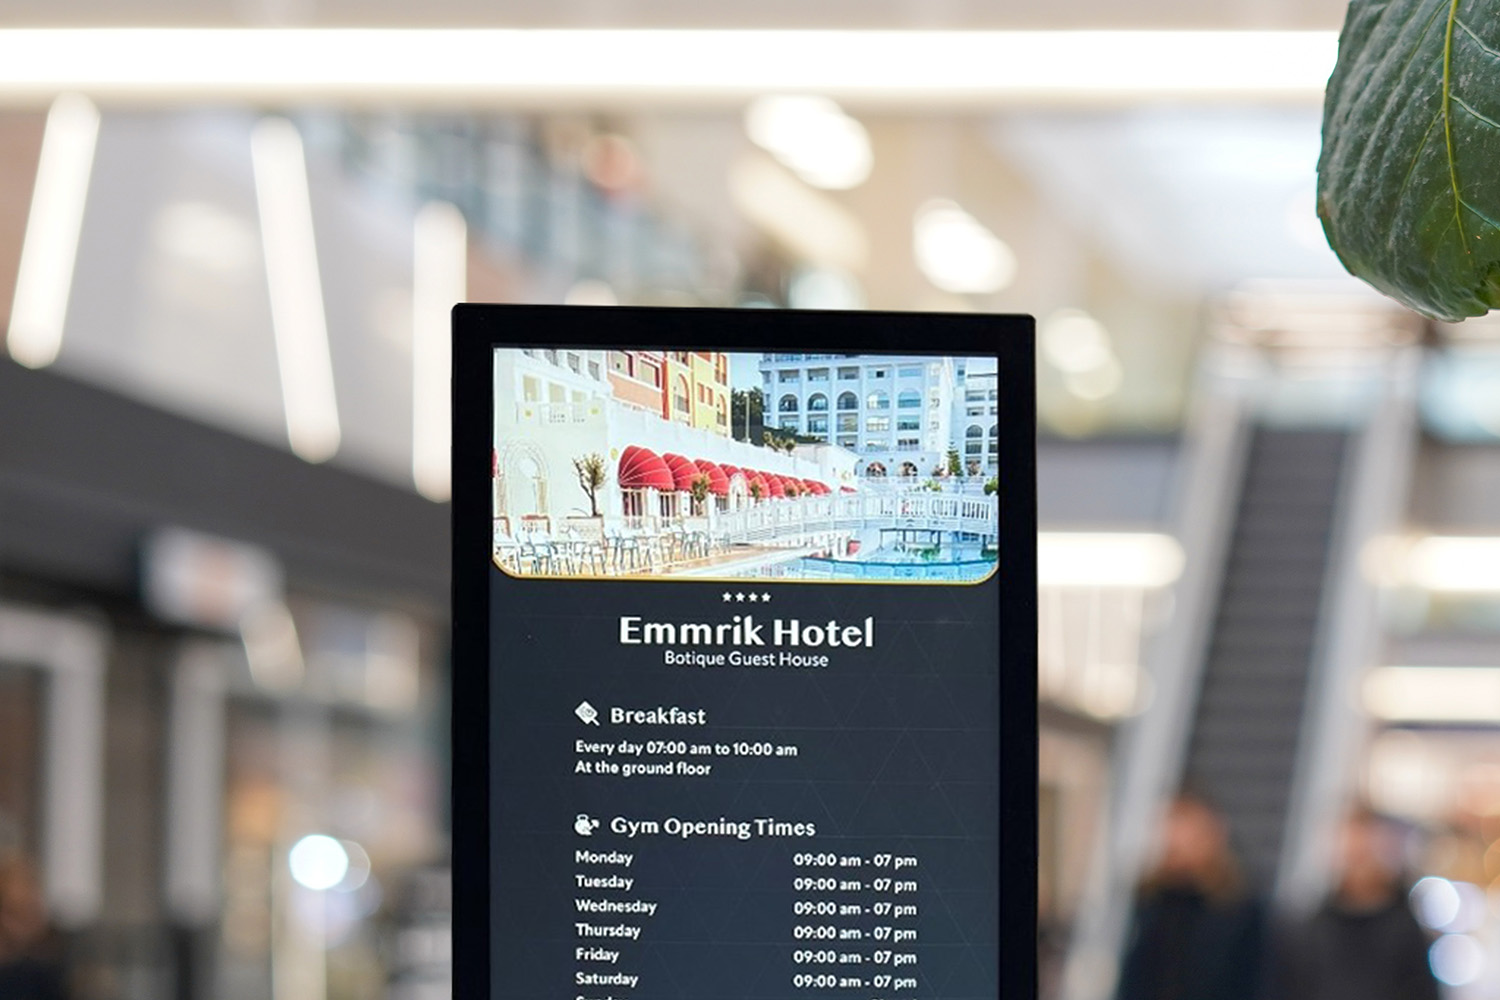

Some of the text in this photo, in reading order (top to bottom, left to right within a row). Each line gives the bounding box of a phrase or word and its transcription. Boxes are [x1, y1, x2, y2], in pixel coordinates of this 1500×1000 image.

[620, 615, 873, 648] Emmrik Hotel
[664, 649, 829, 669] Botique Guest House
[611, 706, 706, 725] Breakfast
[575, 739, 798, 757] Every day 07:00 am to 10:00 am
[574, 759, 712, 777] At the ground floor
[610, 816, 816, 840] Gym Opening Times
[575, 850, 634, 867] Monday
[793, 852, 837, 867] 09:00
[839, 856, 862, 867] am
[873, 853, 892, 868] 07
[894, 856, 918, 871] pm
[575, 874, 634, 891] Tuesday
[793, 877, 837, 891] 09:00
[839, 880, 862, 891] am
[873, 877, 892, 891] 07
[894, 881, 917, 894] pm
[575, 898, 658, 917] Wednesday
[793, 901, 837, 916] 09:00
[839, 904, 862, 916] am
[873, 902, 892, 916] 07
[894, 905, 917, 919] pm
[574, 922, 641, 941] Thursday
[793, 925, 837, 940] 09:00
[839, 928, 862, 940] am
[873, 926, 893, 941] 07
[893, 929, 917, 943] pm
[575, 947, 620, 964] Friday
[793, 950, 837, 964] 09:00
[838, 953, 862, 964] am
[873, 950, 893, 964] 07
[893, 953, 917, 967] pm
[575, 971, 639, 988] Saturday
[793, 974, 837, 988] 09:00
[839, 977, 862, 988] am
[873, 974, 892, 988] 07
[893, 977, 917, 991] pm
